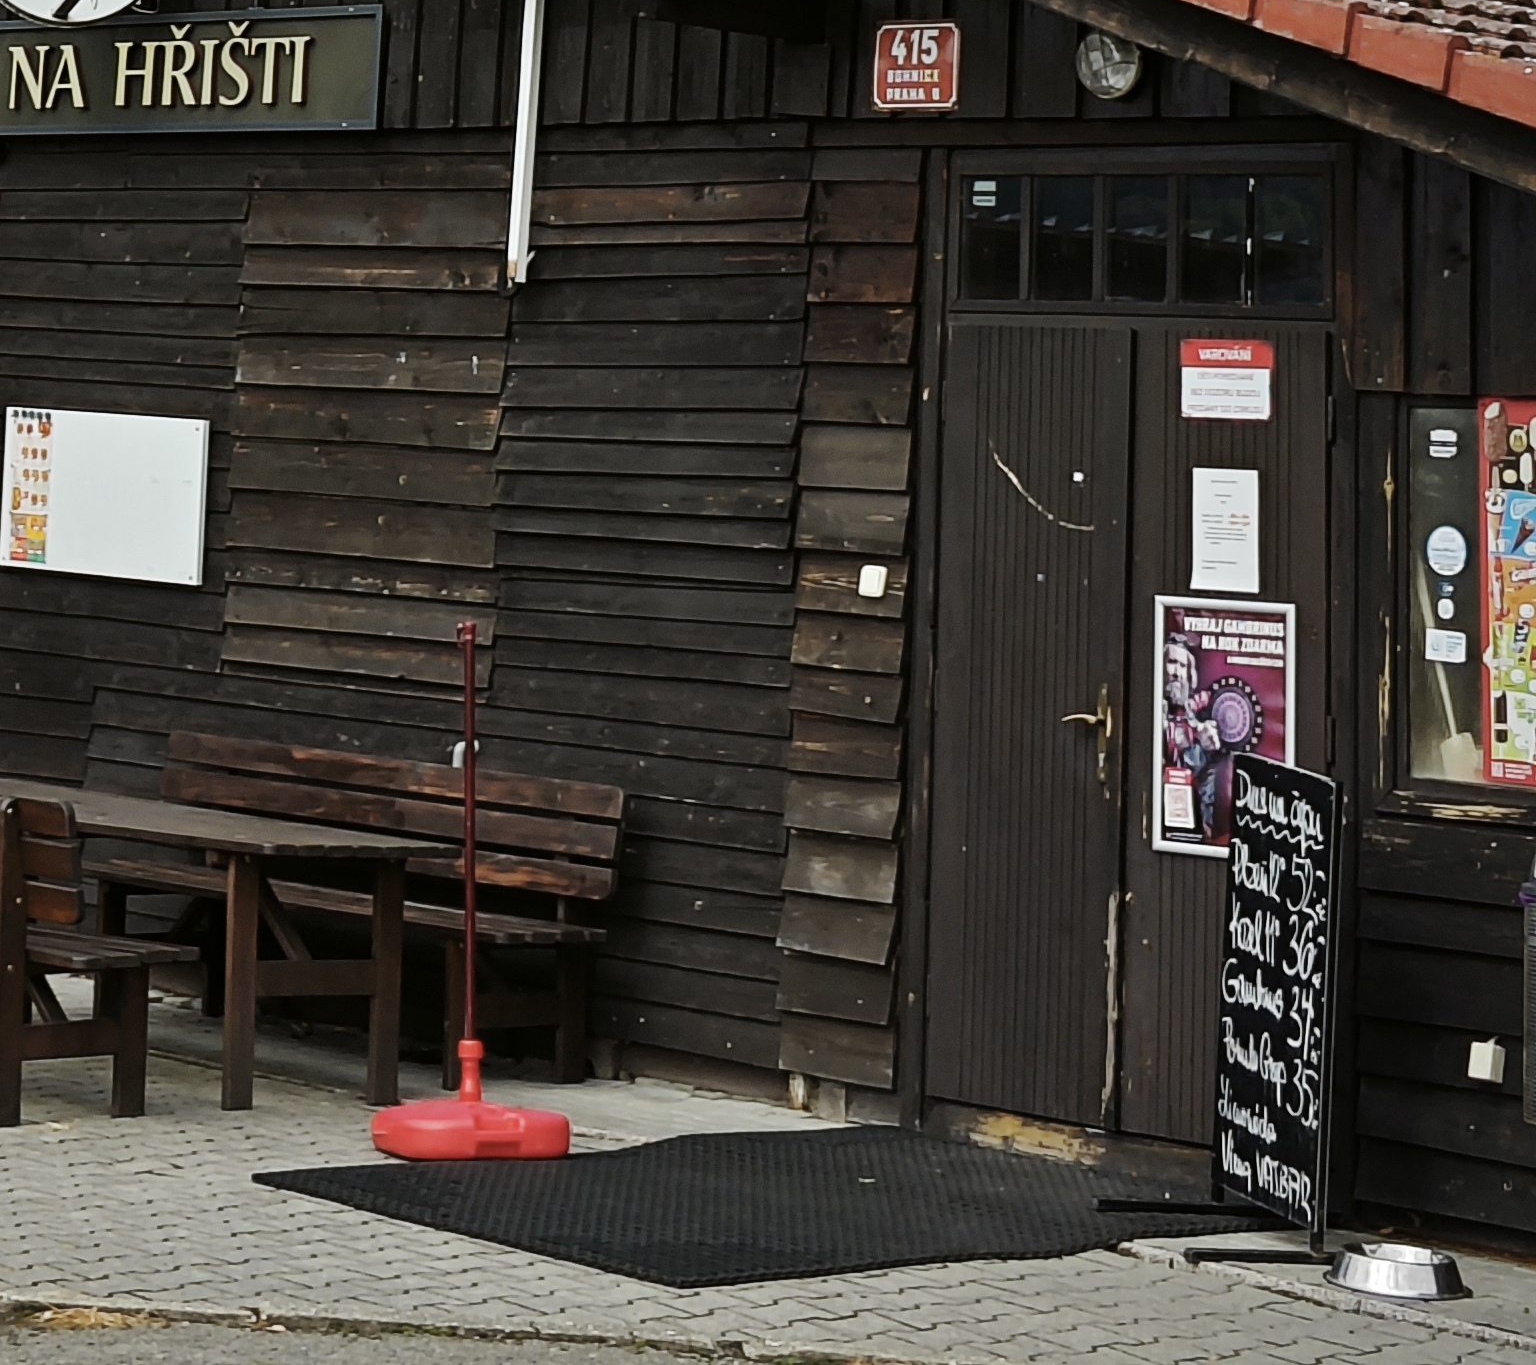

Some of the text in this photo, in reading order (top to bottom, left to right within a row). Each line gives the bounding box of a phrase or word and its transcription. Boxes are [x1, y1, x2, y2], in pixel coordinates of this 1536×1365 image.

[8, 20, 312, 110] NA HŘIŠTI
[890, 29, 940, 66] 415
